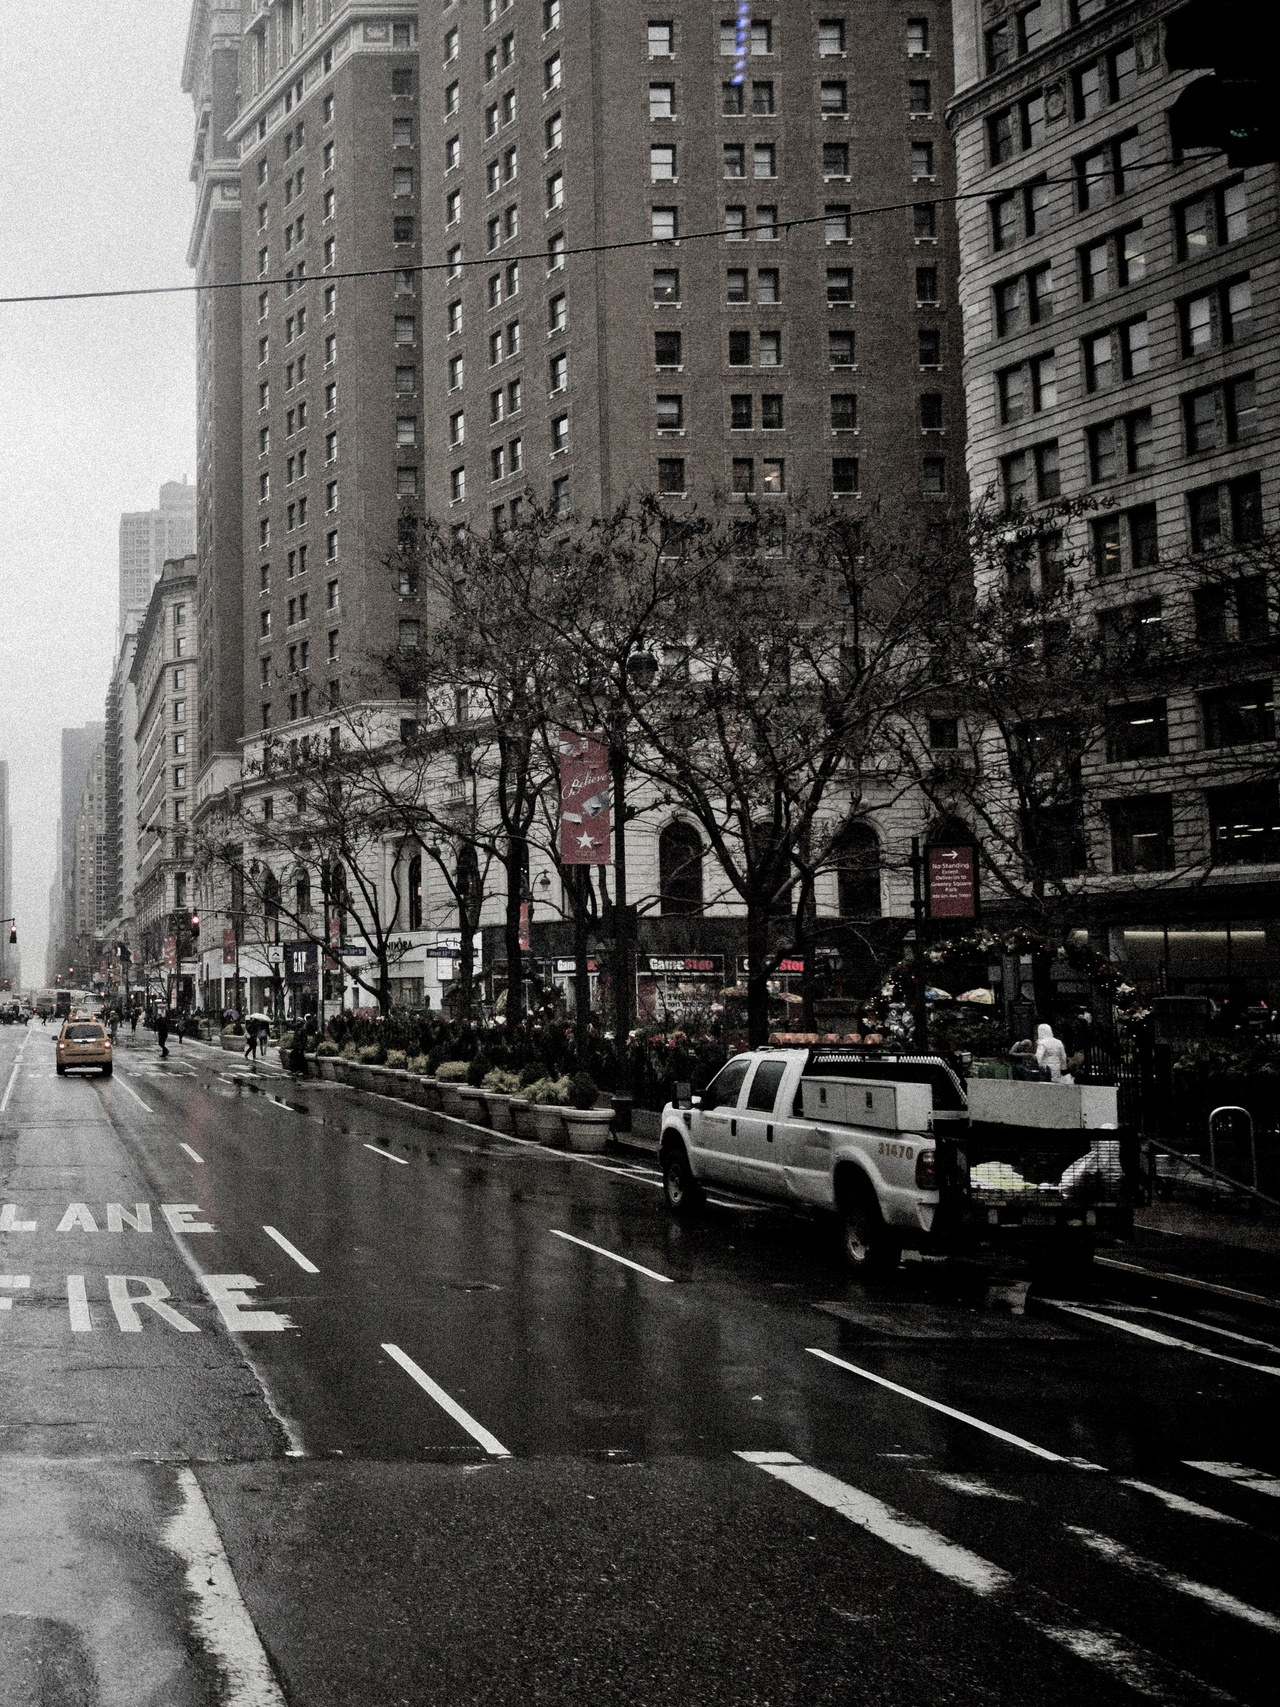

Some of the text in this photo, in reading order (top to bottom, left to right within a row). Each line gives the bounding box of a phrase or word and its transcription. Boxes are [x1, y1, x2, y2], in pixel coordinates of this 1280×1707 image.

[561, 769, 609, 800] Believe
[942, 862, 970, 870] Standing
[649, 957, 714, 971] GameStop
[878, 1141, 914, 1160] 31470
